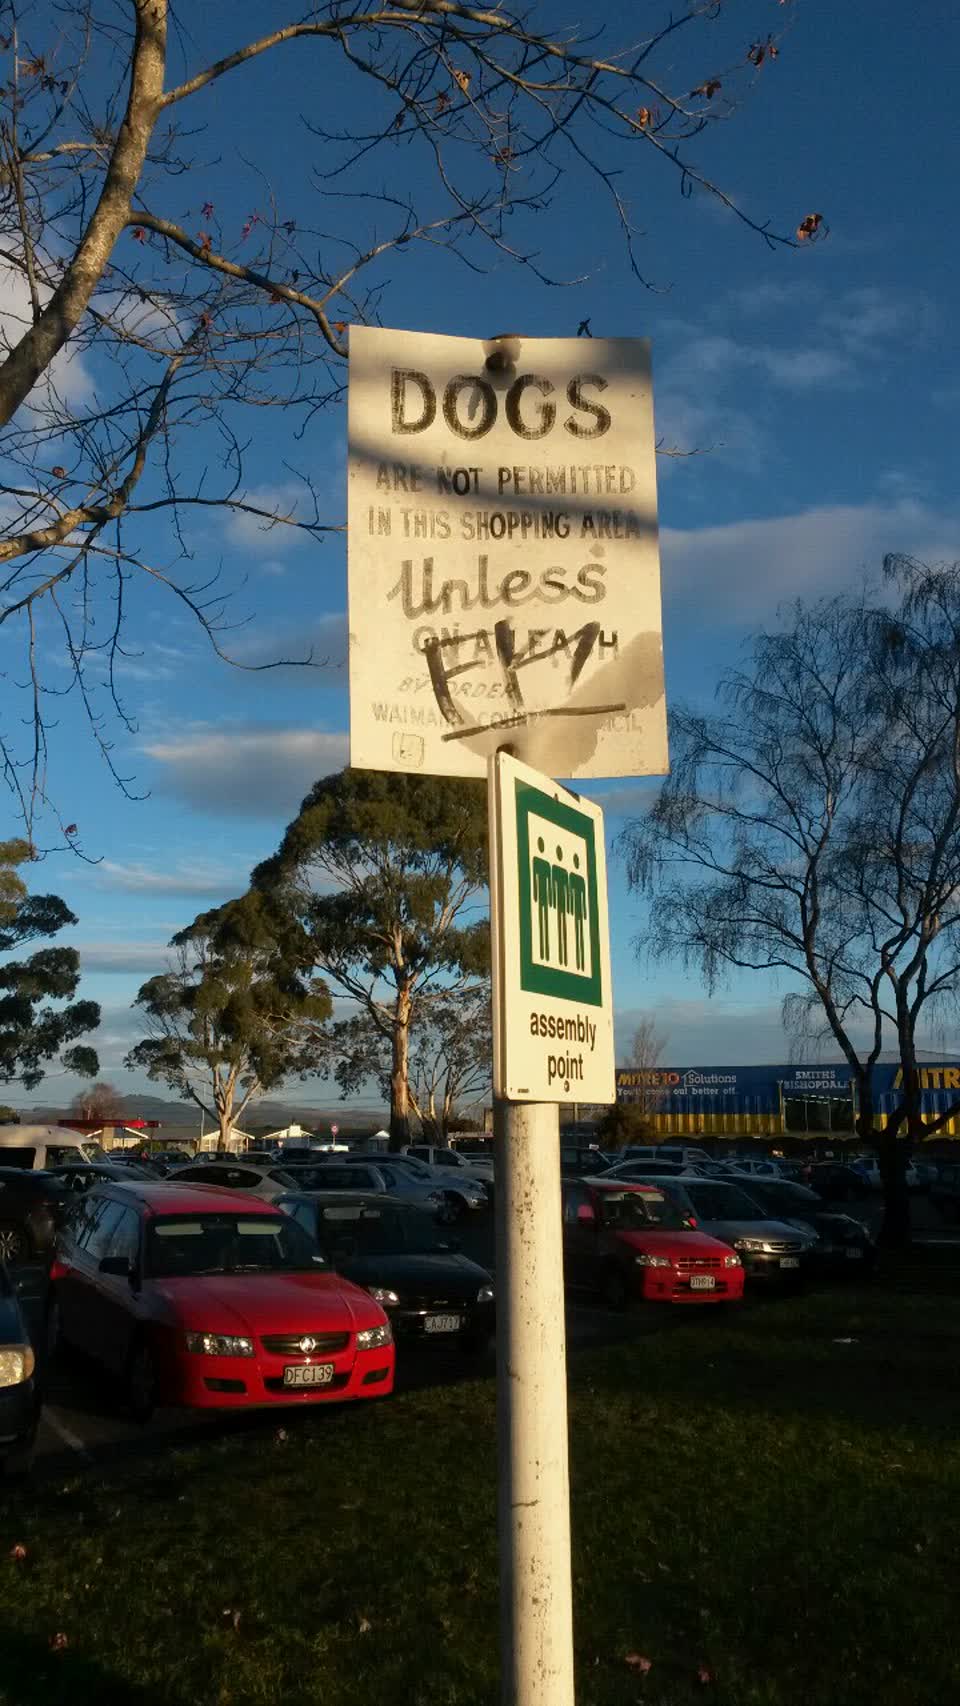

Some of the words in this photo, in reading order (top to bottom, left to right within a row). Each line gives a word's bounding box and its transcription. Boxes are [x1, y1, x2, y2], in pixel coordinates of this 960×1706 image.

[391, 366, 612, 442] DOGS
[375, 462, 425, 493] ARE
[437, 466, 484, 496] NOT
[498, 464, 638, 496] PERMITTED
[368, 505, 390, 537] IN
[400, 507, 452, 540] THIS
[462, 509, 570, 541] SHOPPING
[580, 508, 641, 540] AREA
[387, 554, 608, 620] Unless
[529, 1012, 597, 1052] assembly
[547, 1050, 584, 1086] point
[688, 1073, 737, 1084] Solutions
[783, 1080, 850, 1089] BISHOPDALE
[795, 1070, 836, 1080] SMITHS
[673, 1087, 688, 1096] out
[692, 1086, 719, 1095] better
[285, 1365, 332, 1383] DFC139
